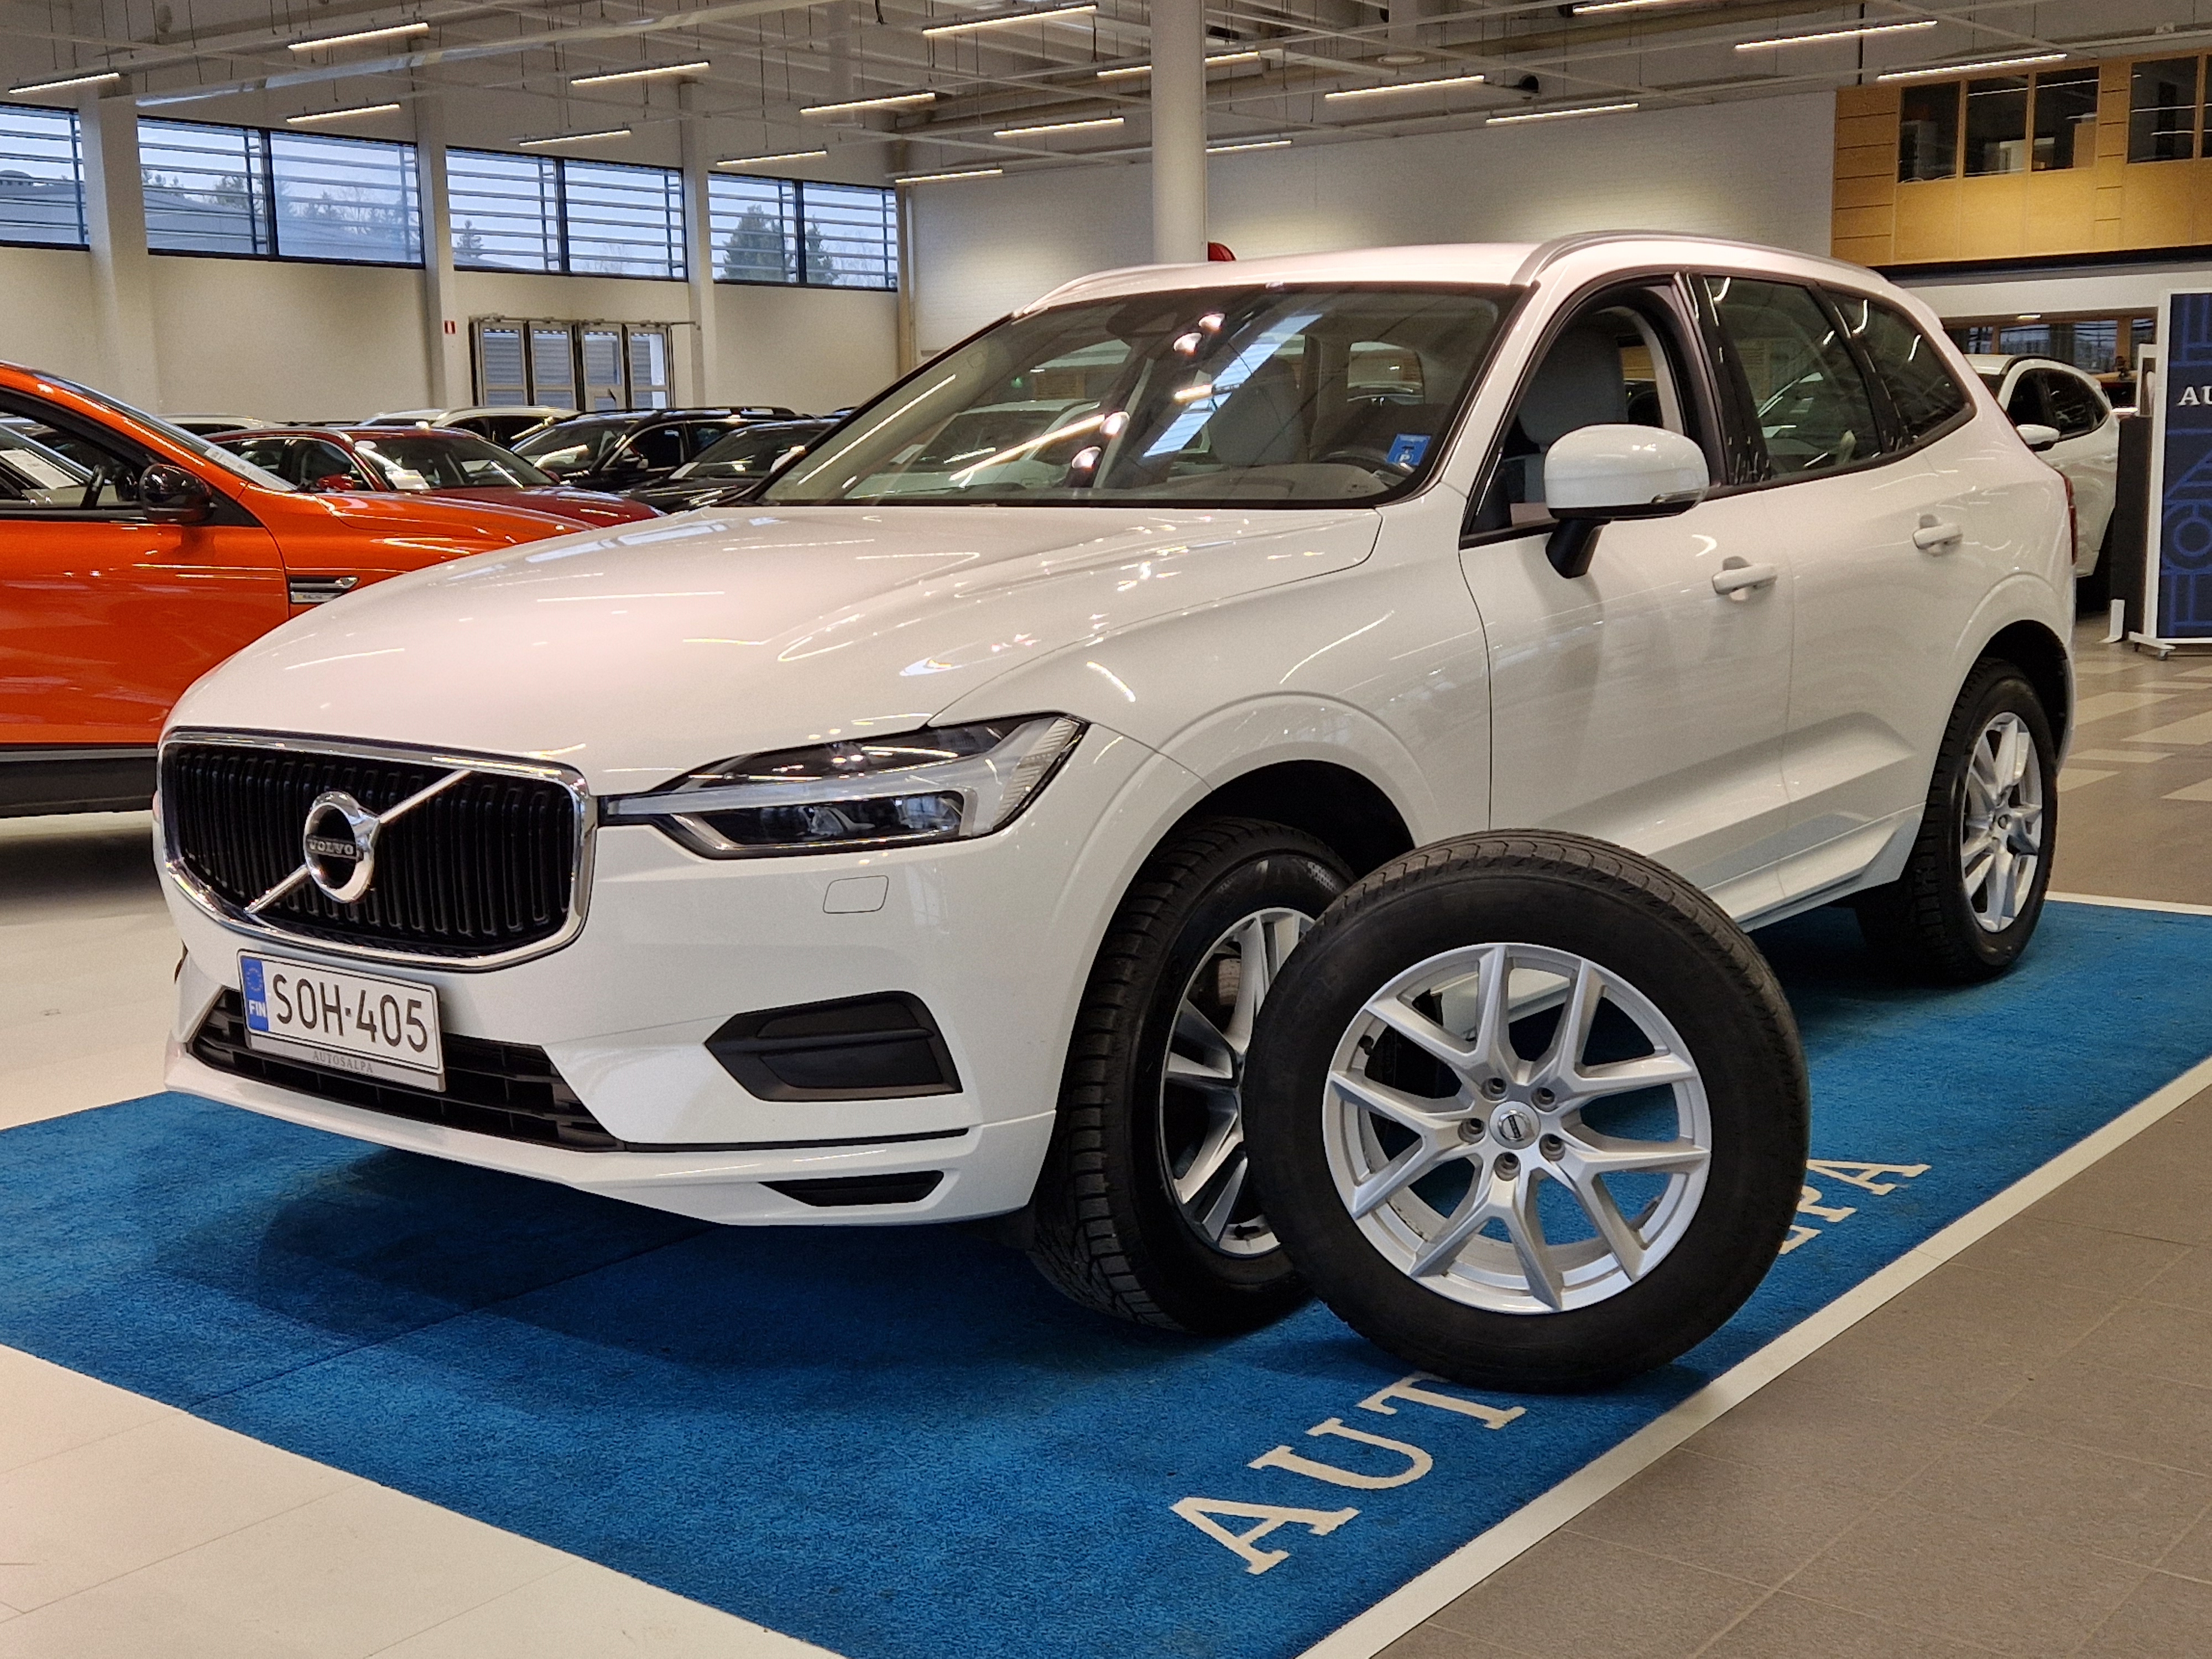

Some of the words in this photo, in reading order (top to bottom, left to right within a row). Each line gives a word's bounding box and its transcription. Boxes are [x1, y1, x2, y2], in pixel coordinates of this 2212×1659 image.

[307, 838, 354, 855] VOLVO
[249, 999, 267, 1017] FIN
[273, 974, 428, 1053] SOH-405
[312, 1051, 374, 1073] AUTOSALPA
